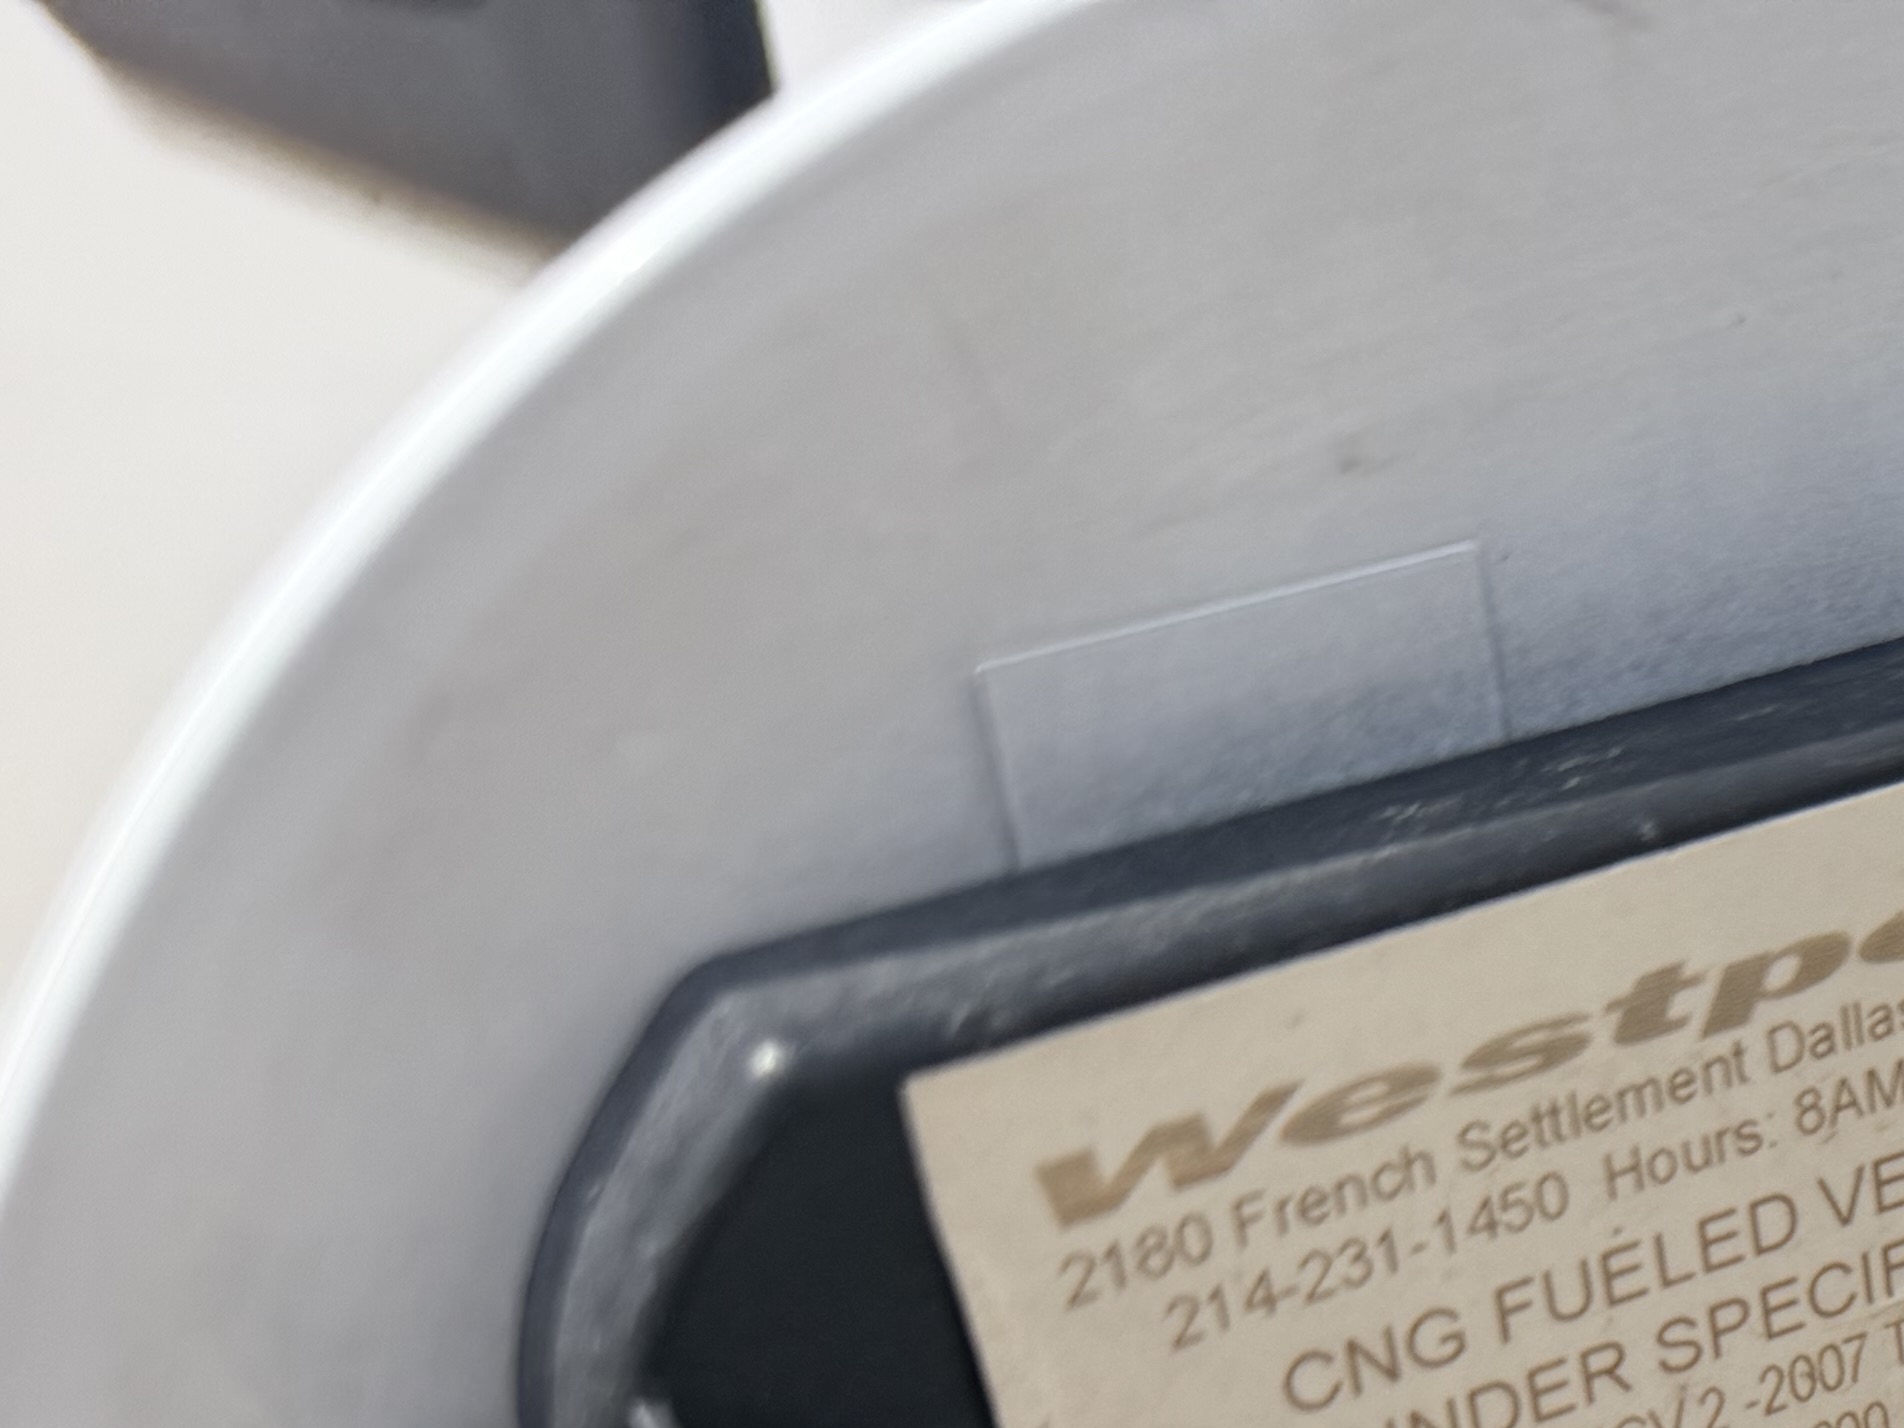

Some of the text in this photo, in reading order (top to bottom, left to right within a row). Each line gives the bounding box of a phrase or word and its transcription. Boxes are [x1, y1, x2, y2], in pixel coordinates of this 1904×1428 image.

[1058, 1211, 1213, 1312] 2180
[1229, 1143, 1437, 1250] French
[1456, 1038, 1750, 1172] Settlement
[1163, 1169, 1570, 1353] 214-231-1450
[1603, 1110, 1779, 1201] Hours:
[1283, 1306, 1467, 1413] CNG
[1495, 1192, 1798, 1345] FUELED
